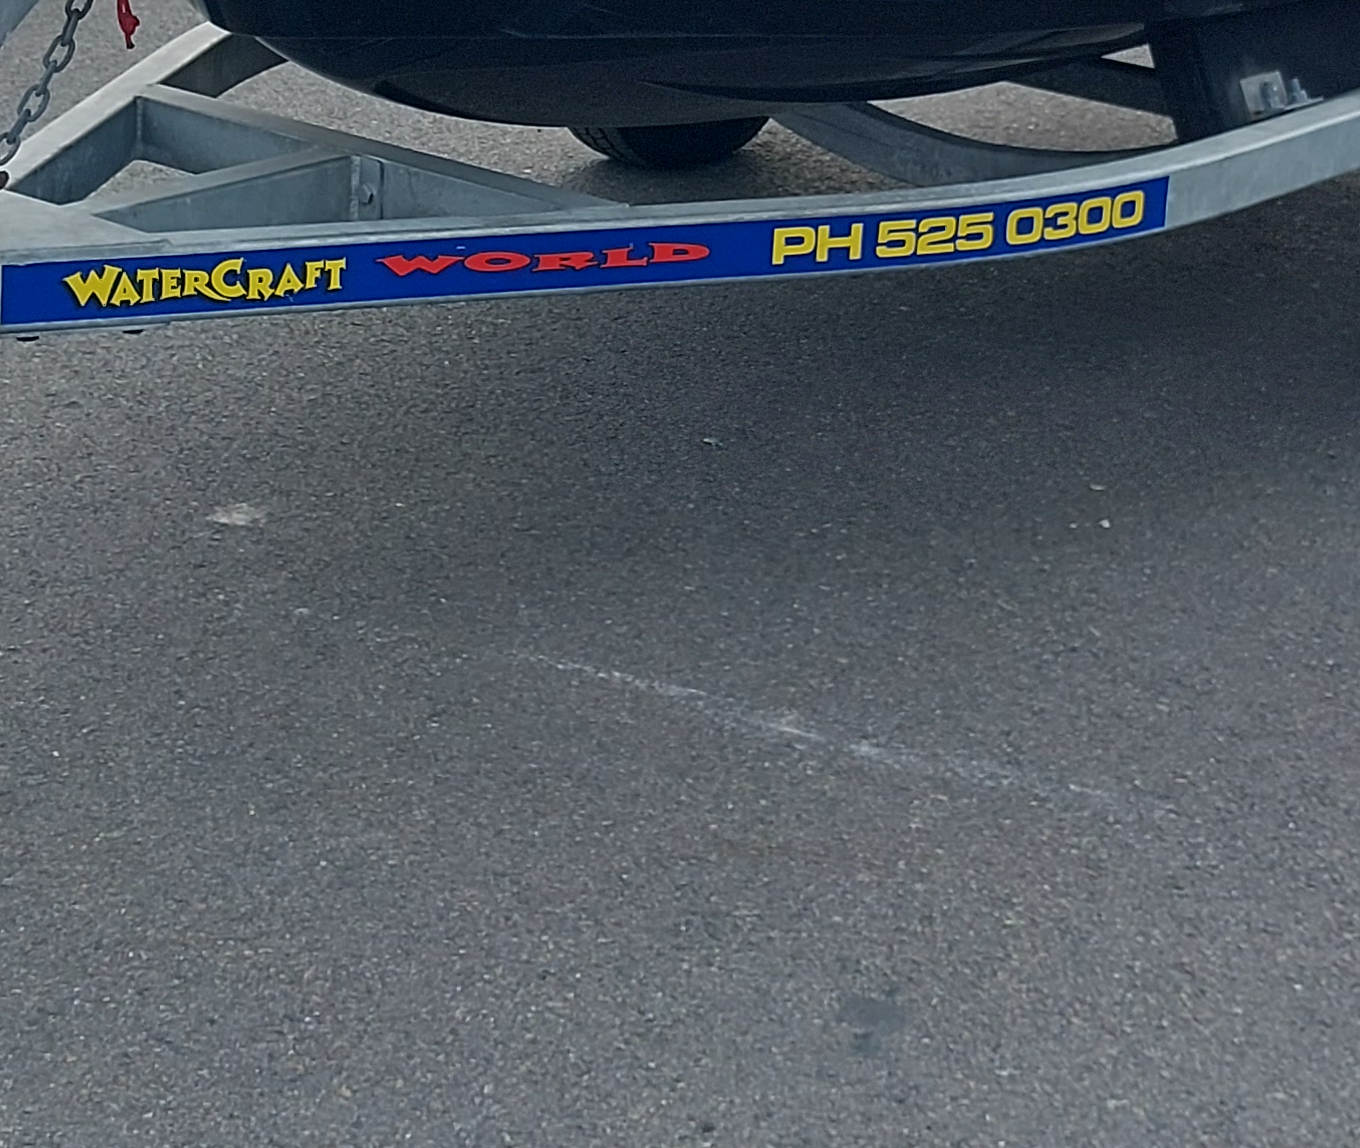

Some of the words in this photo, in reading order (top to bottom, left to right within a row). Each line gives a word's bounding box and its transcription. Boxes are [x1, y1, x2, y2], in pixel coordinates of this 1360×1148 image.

[375, 243, 710, 276] WORLD
[771, 223, 864, 265] PH
[875, 212, 994, 258] 525
[1006, 190, 1145, 245] 0300
